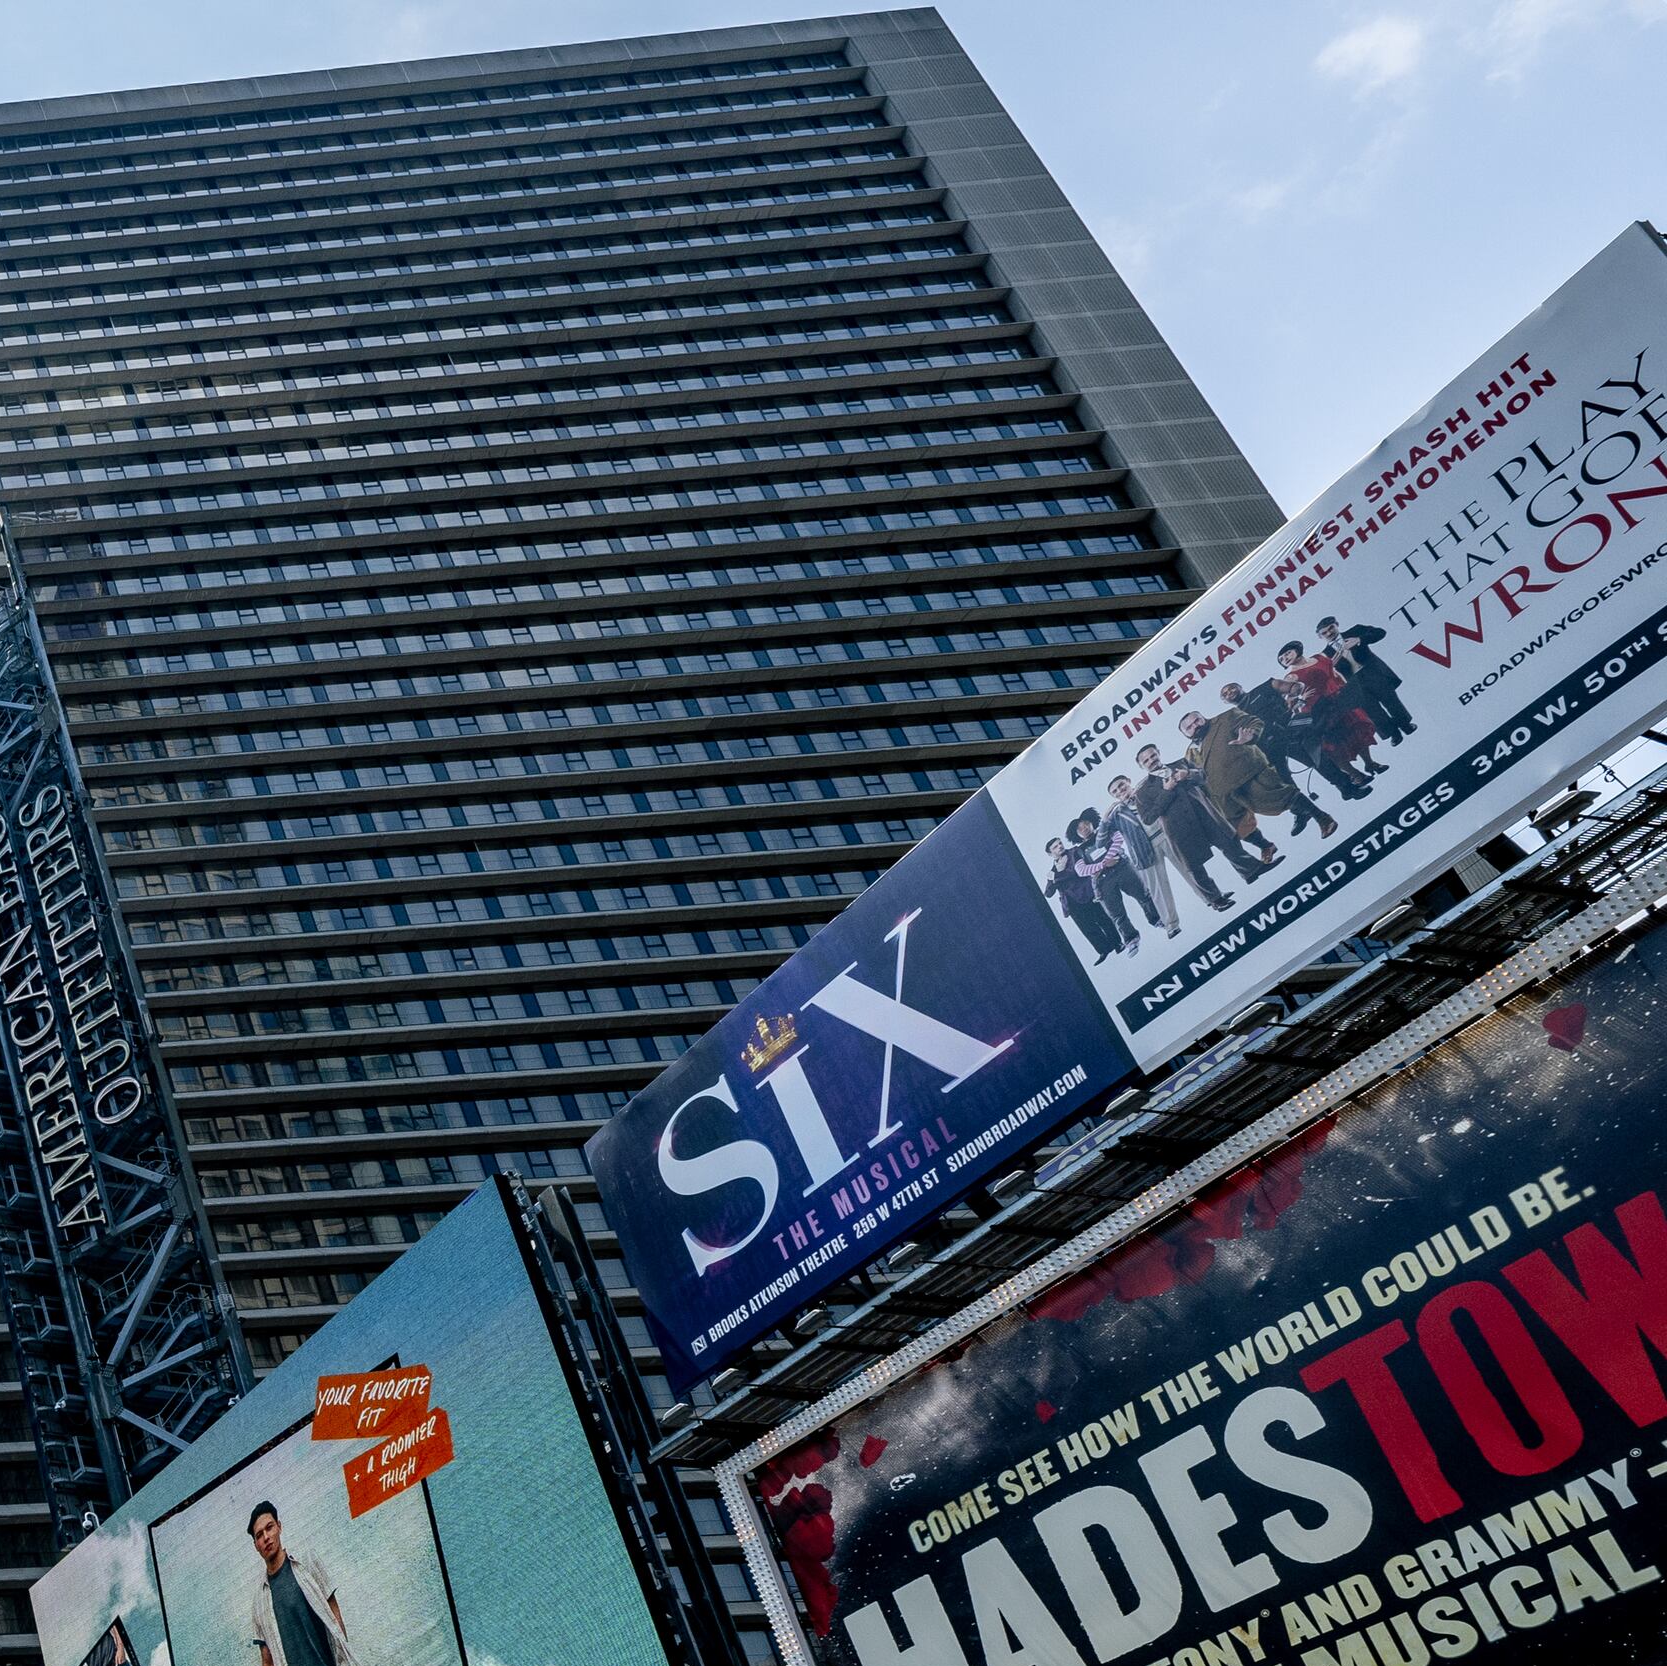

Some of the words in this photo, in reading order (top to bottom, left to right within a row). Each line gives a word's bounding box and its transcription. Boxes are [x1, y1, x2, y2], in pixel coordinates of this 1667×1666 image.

[1068, 737, 1119, 786] AND
[1122, 562, 1333, 741] INTERNATIONAL
[1338, 369, 1558, 561] PHENOMENON
[1219, 505, 1354, 627] FUNNIEST
[1363, 407, 1472, 502] SMASH
[1473, 352, 1534, 409] HIT
[1388, 521, 1517, 631] THAT
[1394, 504, 1495, 582] THE
[1486, 346, 1658, 507] PLAY
[19, 782, 147, 1127] OUTFITTERS
[1190, 928, 1250, 979] NEW
[1251, 858, 1350, 940] WORLD
[1349, 780, 1457, 863] STAGES
[1471, 722, 1533, 775] 340
[656, 906, 1016, 1278] SIX
[707, 1306, 750, 1344] BROOKS
[748, 1267, 800, 1314] ATKINSON
[798, 1236, 849, 1284] THEATRE
[852, 1213, 877, 1240] 256
[891, 1181, 923, 1212] 47TH
[921, 1168, 940, 1191] ST
[945, 1064, 1087, 1173] SIXONBROADWAY.COM
[772, 1210, 827, 1263] THE
[830, 1116, 958, 1218] MUSICAL
[317, 1384, 356, 1415] YOUR
[360, 1376, 429, 1402] FAVORITE
[357, 1407, 385, 1429] FIT
[367, 1455, 374, 1473] A
[381, 1415, 437, 1466] ROOMIER
[379, 1456, 416, 1492] THIGH
[908, 1477, 996, 1553] COME
[997, 1449, 1062, 1512] SEE
[1060, 1404, 1142, 1476] HOW
[1143, 1363, 1221, 1427] THE
[1215, 1284, 1364, 1385] WORLD
[1362, 1205, 1512, 1302] COULD
[1510, 1166, 1596, 1233] BE.
[1286, 1577, 1390, 1651] AND
